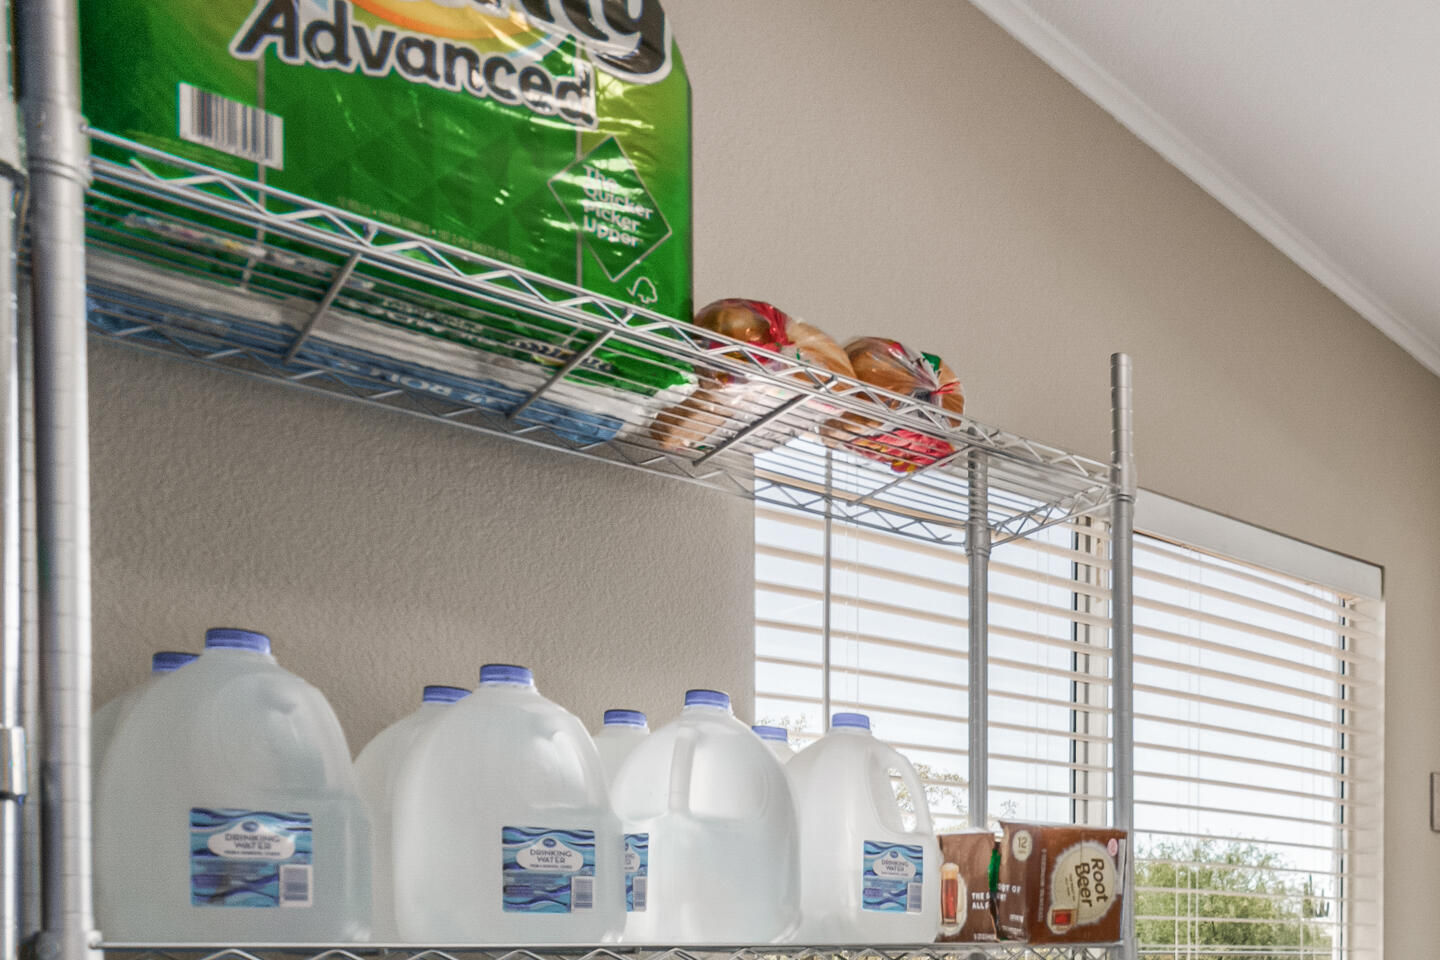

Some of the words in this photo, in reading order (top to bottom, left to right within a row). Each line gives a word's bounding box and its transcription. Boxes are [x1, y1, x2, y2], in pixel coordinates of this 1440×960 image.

[234, 0, 596, 125] Advanced
[583, 164, 618, 187] The
[583, 186, 653, 219] Quicker
[584, 215, 641, 247] Upper
[530, 849, 572, 858] DRINKING
[1017, 837, 1028, 849] 12
[536, 856, 566, 864] WATER
[1075, 862, 1092, 908] Beer
[1090, 857, 1109, 902] Root
